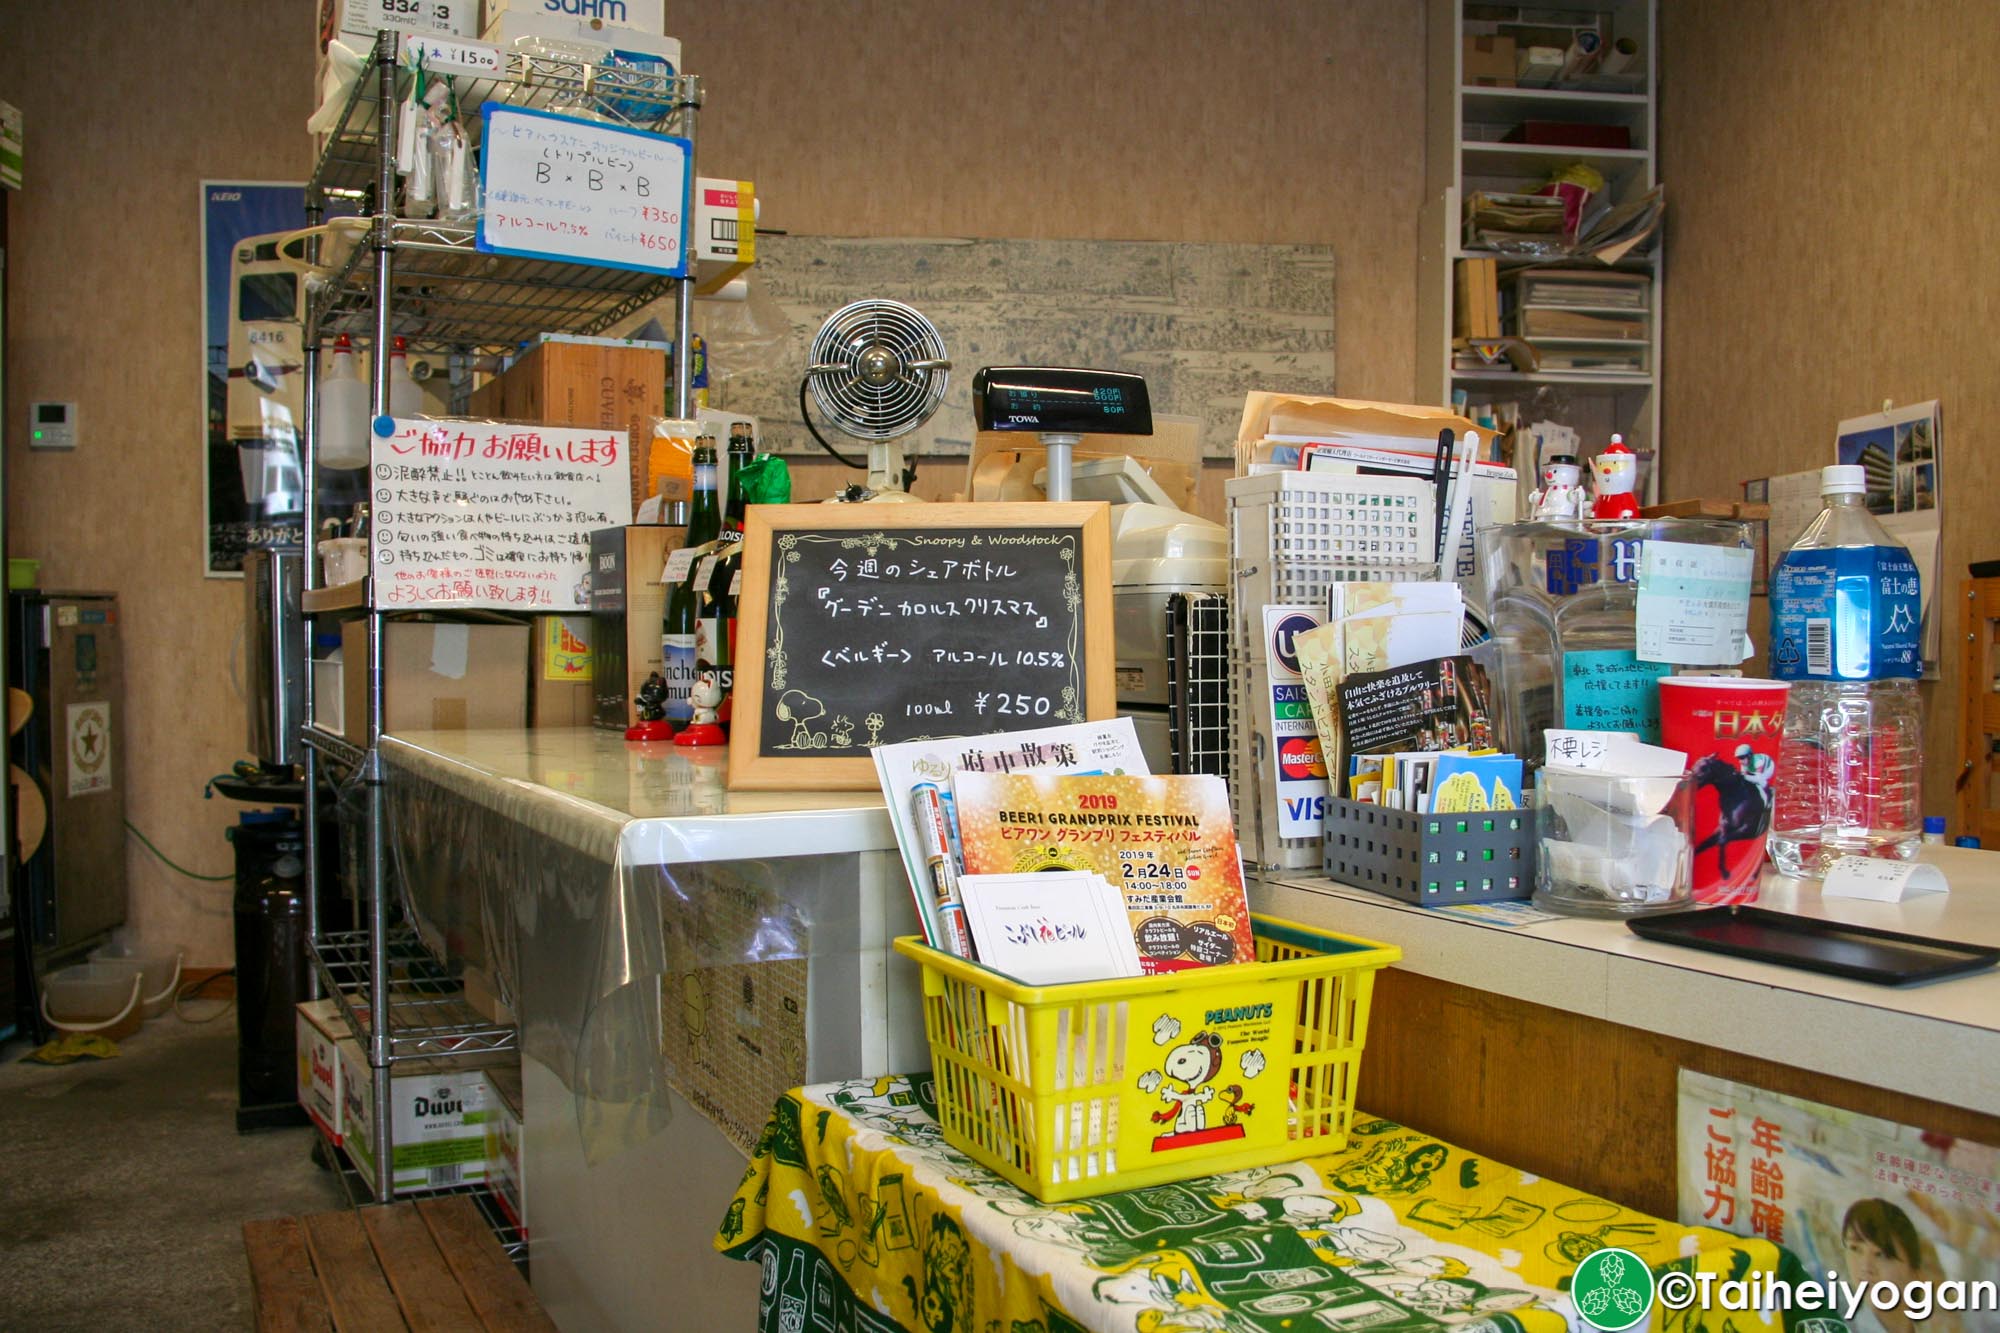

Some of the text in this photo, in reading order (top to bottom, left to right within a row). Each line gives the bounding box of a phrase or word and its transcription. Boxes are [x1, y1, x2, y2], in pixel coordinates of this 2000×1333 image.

[536, 162, 552, 184] B
[588, 169, 604, 191] B
[637, 176, 650, 197] B
[210, 192, 242, 202] KEIO
[641, 206, 680, 226] ¥350
[639, 232, 678, 252] ¥650
[1008, 415, 1040, 423] TOWA
[482, 432, 620, 468] お願いします
[913, 535, 1061, 548] Snoopy & Woodstock
[829, 558, 1017, 582] 今週のシェアボトル
[1880, 576, 1918, 596] 富士の恵
[932, 649, 1009, 667] アルコール
[1016, 650, 1066, 668] 10.5%
[960, 742, 1078, 774] 府中散策
[1078, 794, 1118, 810] 2019
[999, 811, 1200, 827] BEER1 GRANDPRIX FESTIVAL
[1001, 826, 1050, 842] ビアワン
[1120, 828, 1201, 843] フェスティバル
[1187, 868, 1201, 877] SUN
[1204, 1002, 1273, 1026] PEANUTS
[1703, 1106, 1737, 1226] ご協力
